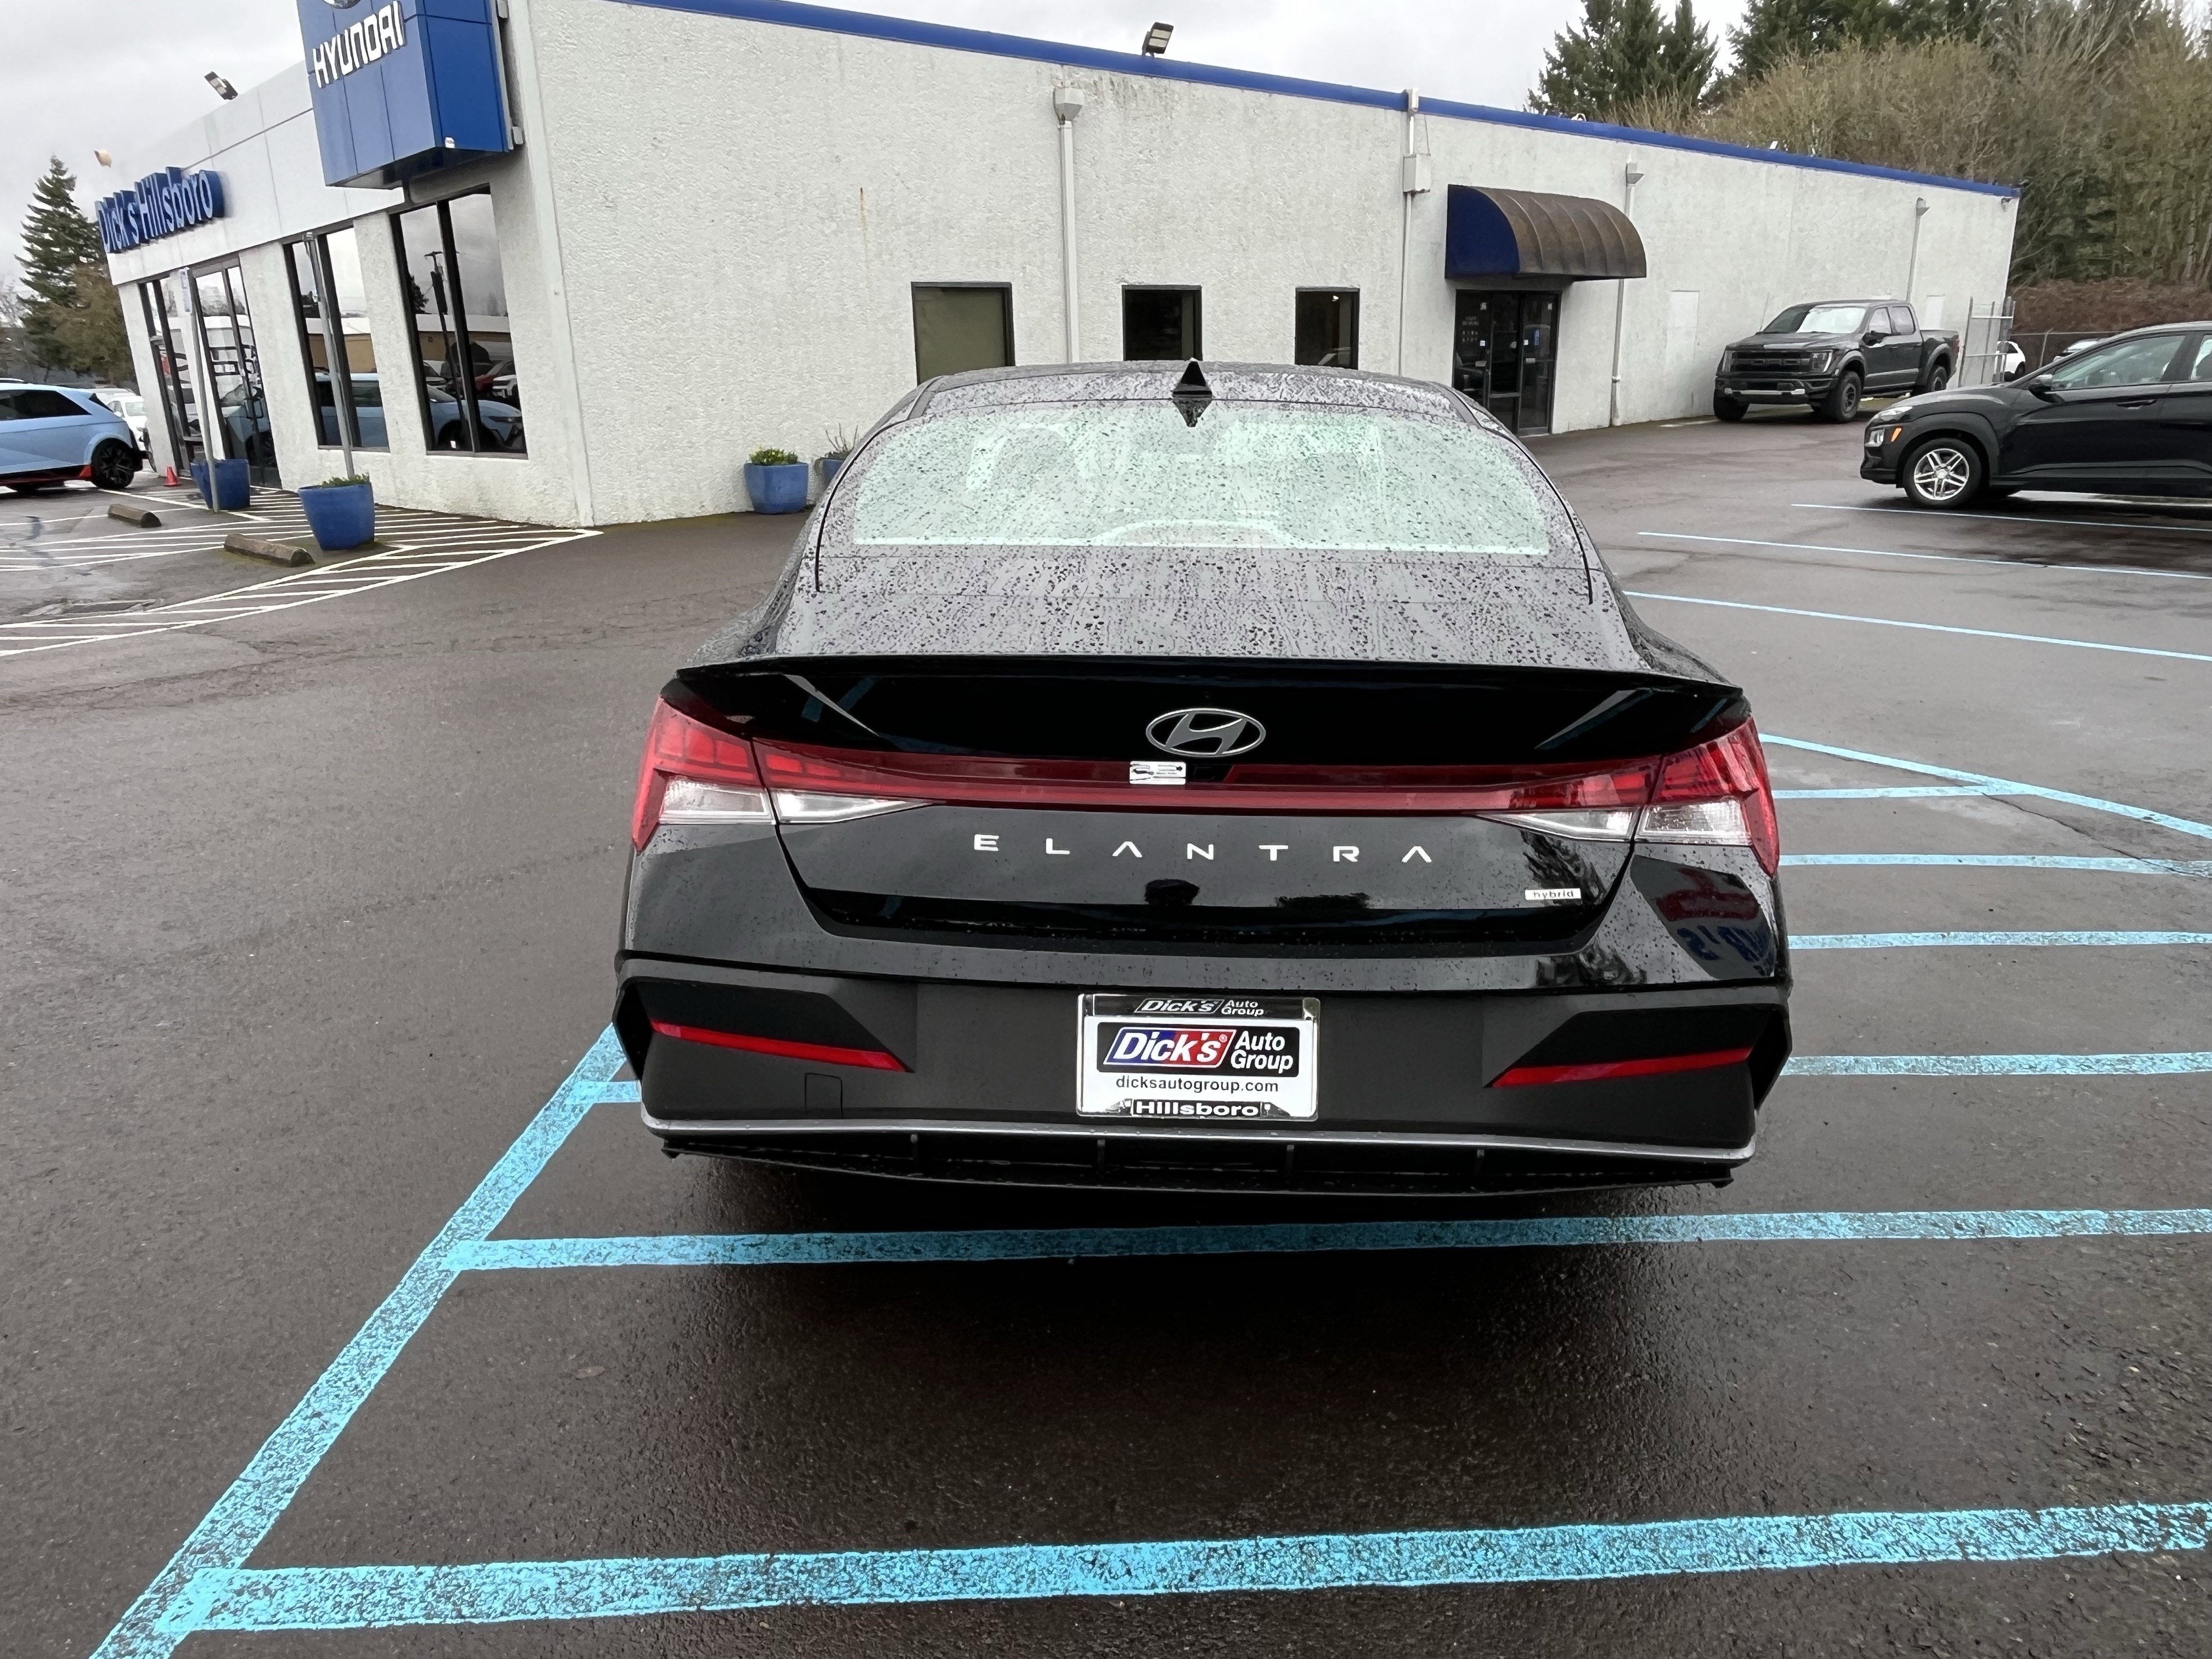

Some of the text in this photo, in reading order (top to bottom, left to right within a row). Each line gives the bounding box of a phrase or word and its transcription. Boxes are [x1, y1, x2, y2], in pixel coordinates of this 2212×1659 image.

[312, 1, 405, 88] HYUNDAI
[94, 166, 213, 253] Dick's Hillsboro
[974, 834, 1432, 863] ELANTRA
[1533, 890, 1574, 899] hybrid
[1141, 1000, 1216, 1012] Dick's
[1221, 1006, 1264, 1017] Group
[1224, 1000, 1259, 1008] Auto
[1113, 1031, 1222, 1063] Dick's
[1234, 1031, 1285, 1051] Auto
[1231, 1049, 1293, 1074] Group
[1116, 1075, 1279, 1093] dicksautogroup.com
[1136, 1101, 1259, 1116] Hillsboro
